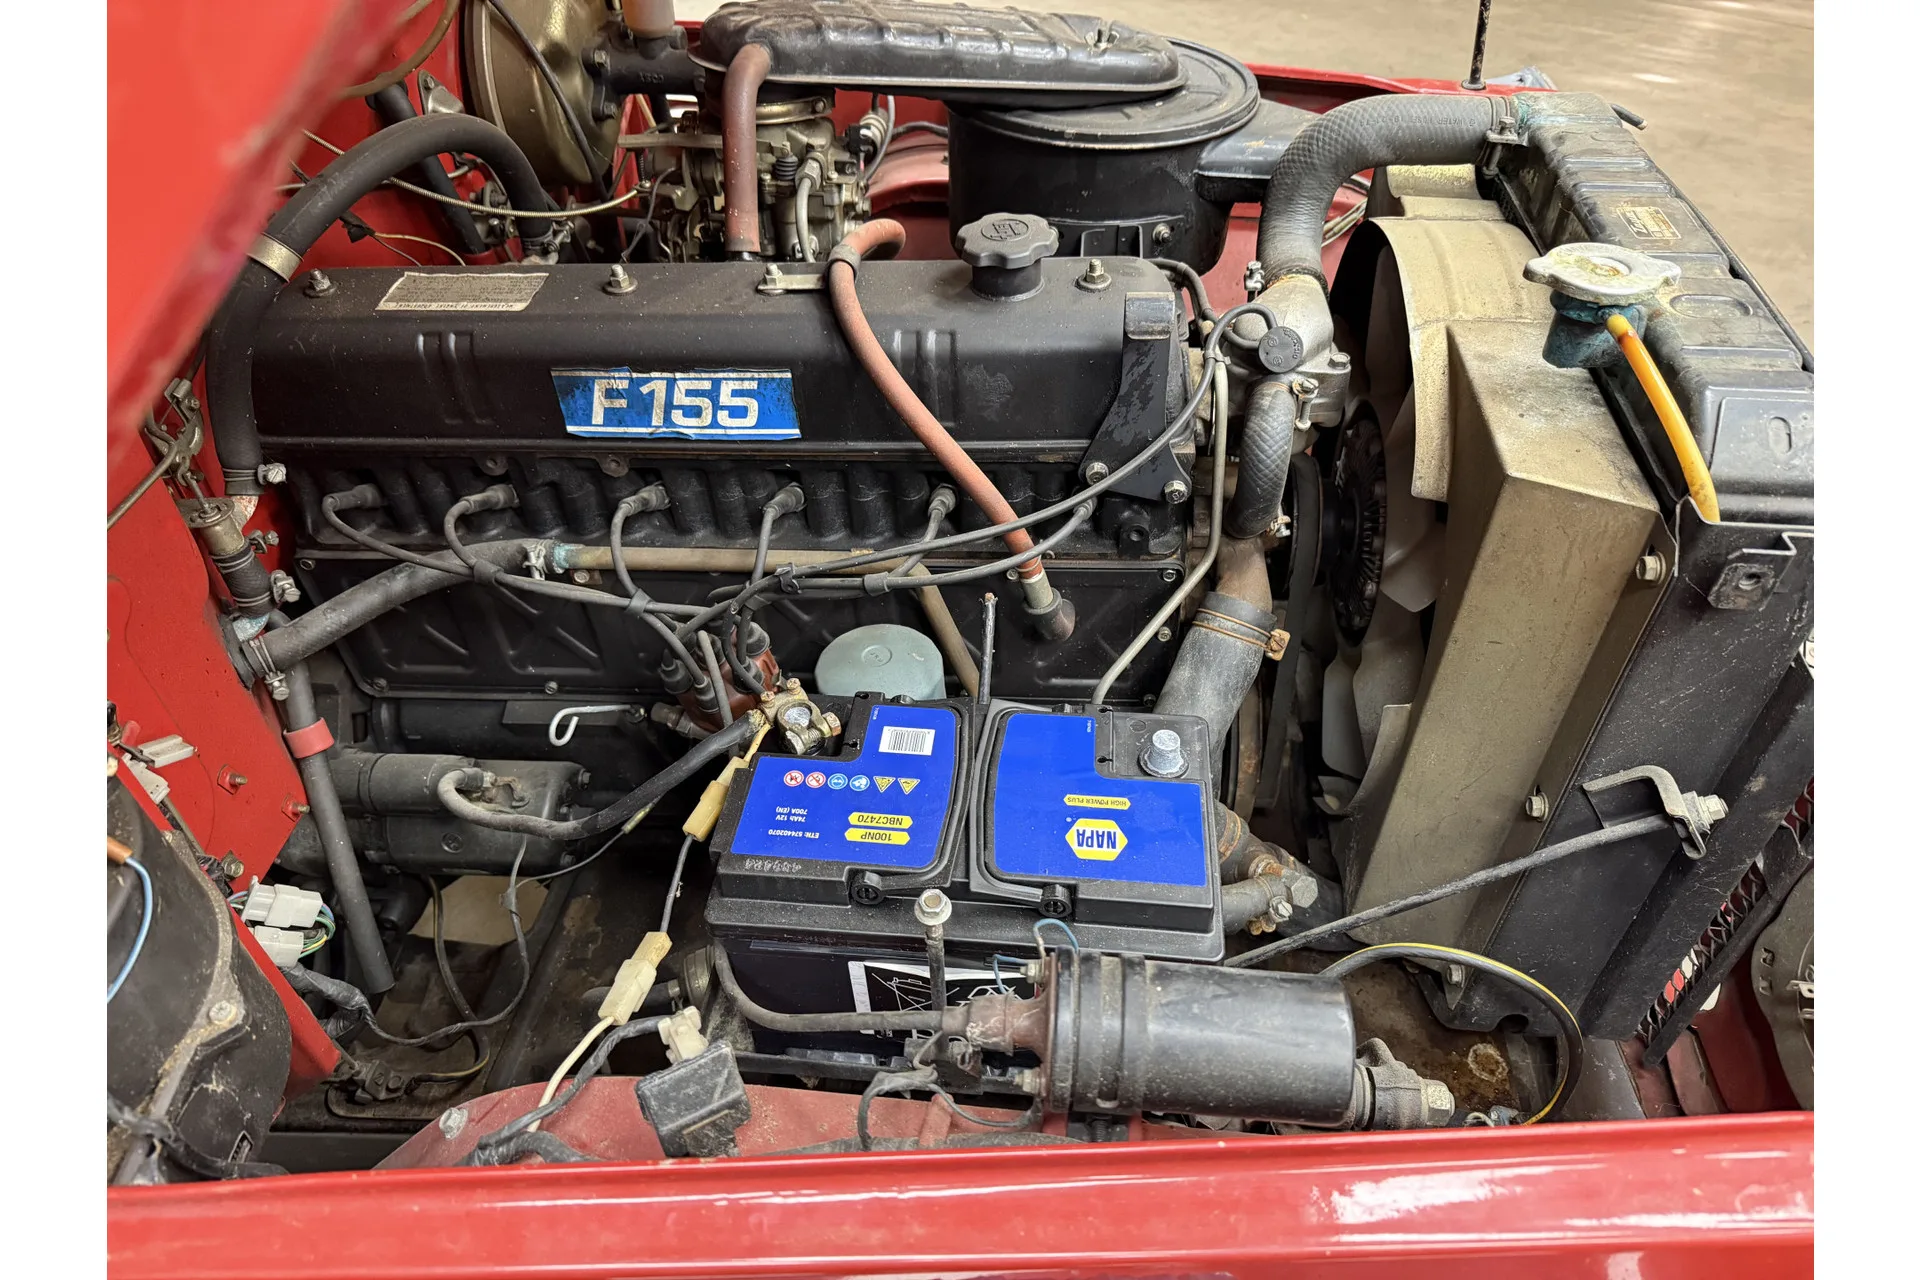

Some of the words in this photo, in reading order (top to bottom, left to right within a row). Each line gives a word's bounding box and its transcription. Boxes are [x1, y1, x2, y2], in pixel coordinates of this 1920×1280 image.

[591, 379, 630, 426] F
[639, 379, 759, 428] 155
[1067, 796, 1084, 804] PLUS
[1085, 798, 1109, 806] POWER
[1110, 799, 1127, 807] HIGH
[775, 806, 790, 814] (EN)
[857, 814, 903, 826] NBC7470
[860, 831, 893, 842] 100NP
[1076, 828, 1117, 850] NAPA
